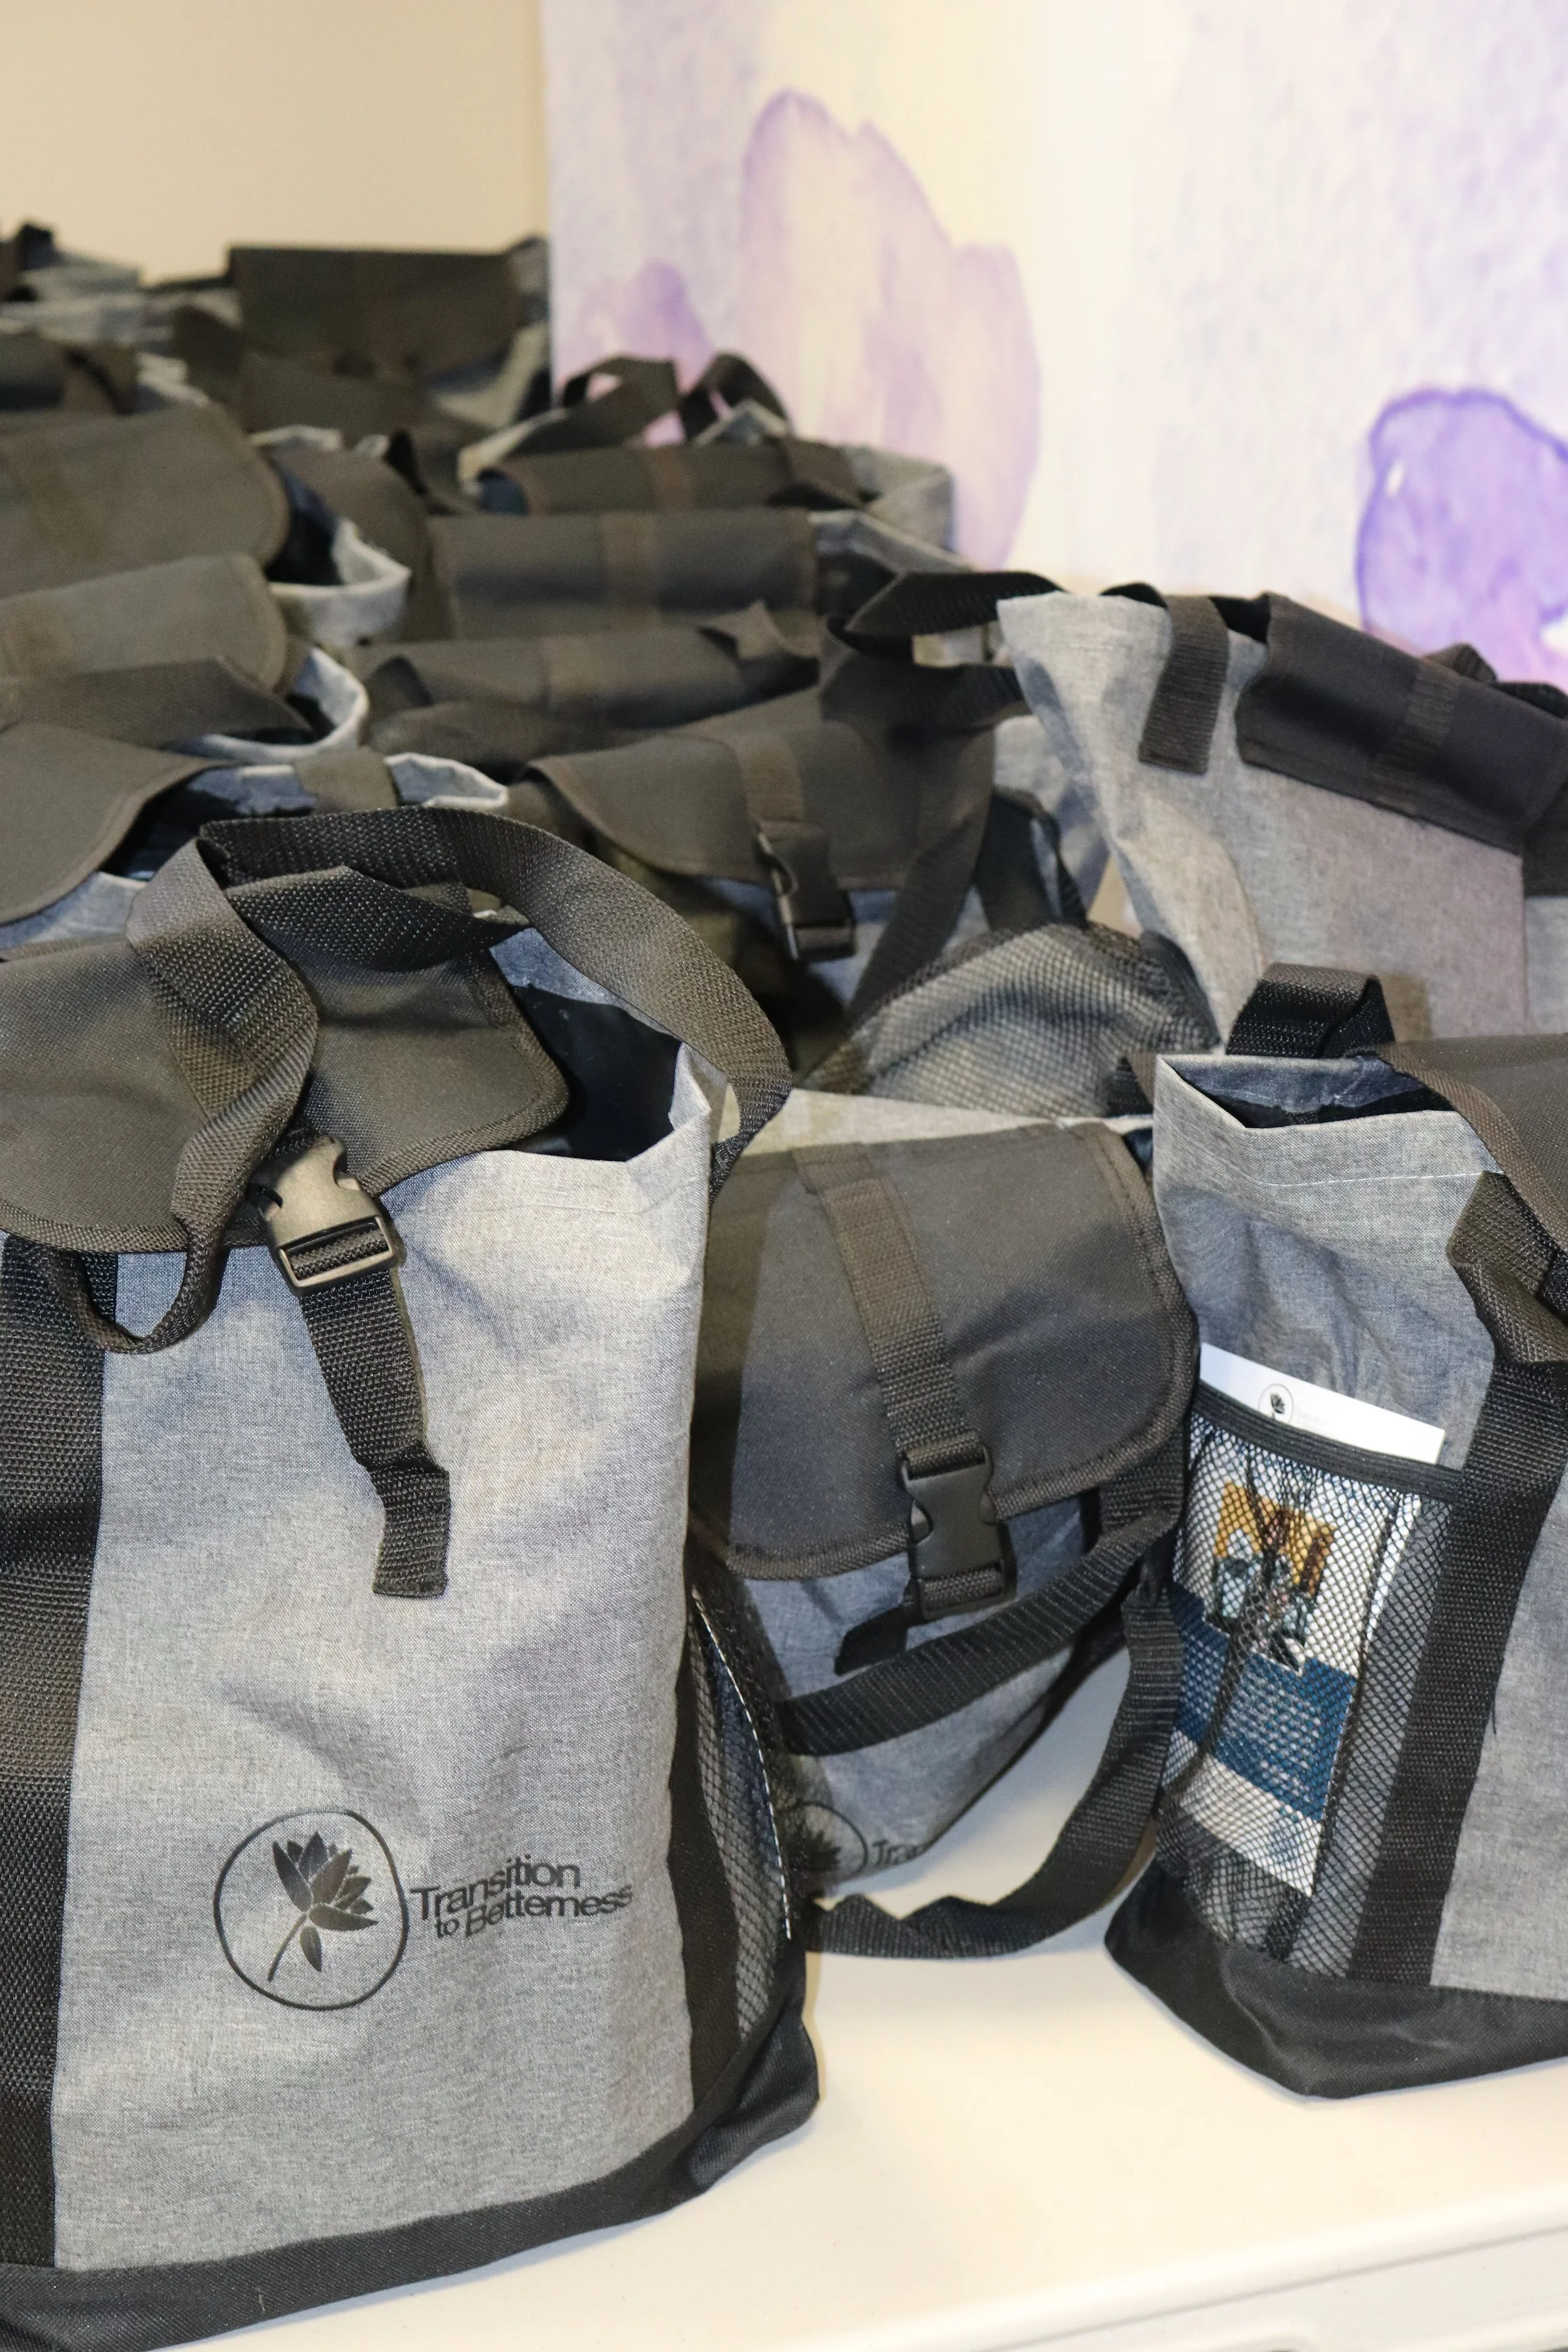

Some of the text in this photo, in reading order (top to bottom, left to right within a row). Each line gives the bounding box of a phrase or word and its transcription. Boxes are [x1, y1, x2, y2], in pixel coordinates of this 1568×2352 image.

[410, 1853, 581, 1920] Transition
[434, 1883, 633, 1938] to Betterness
